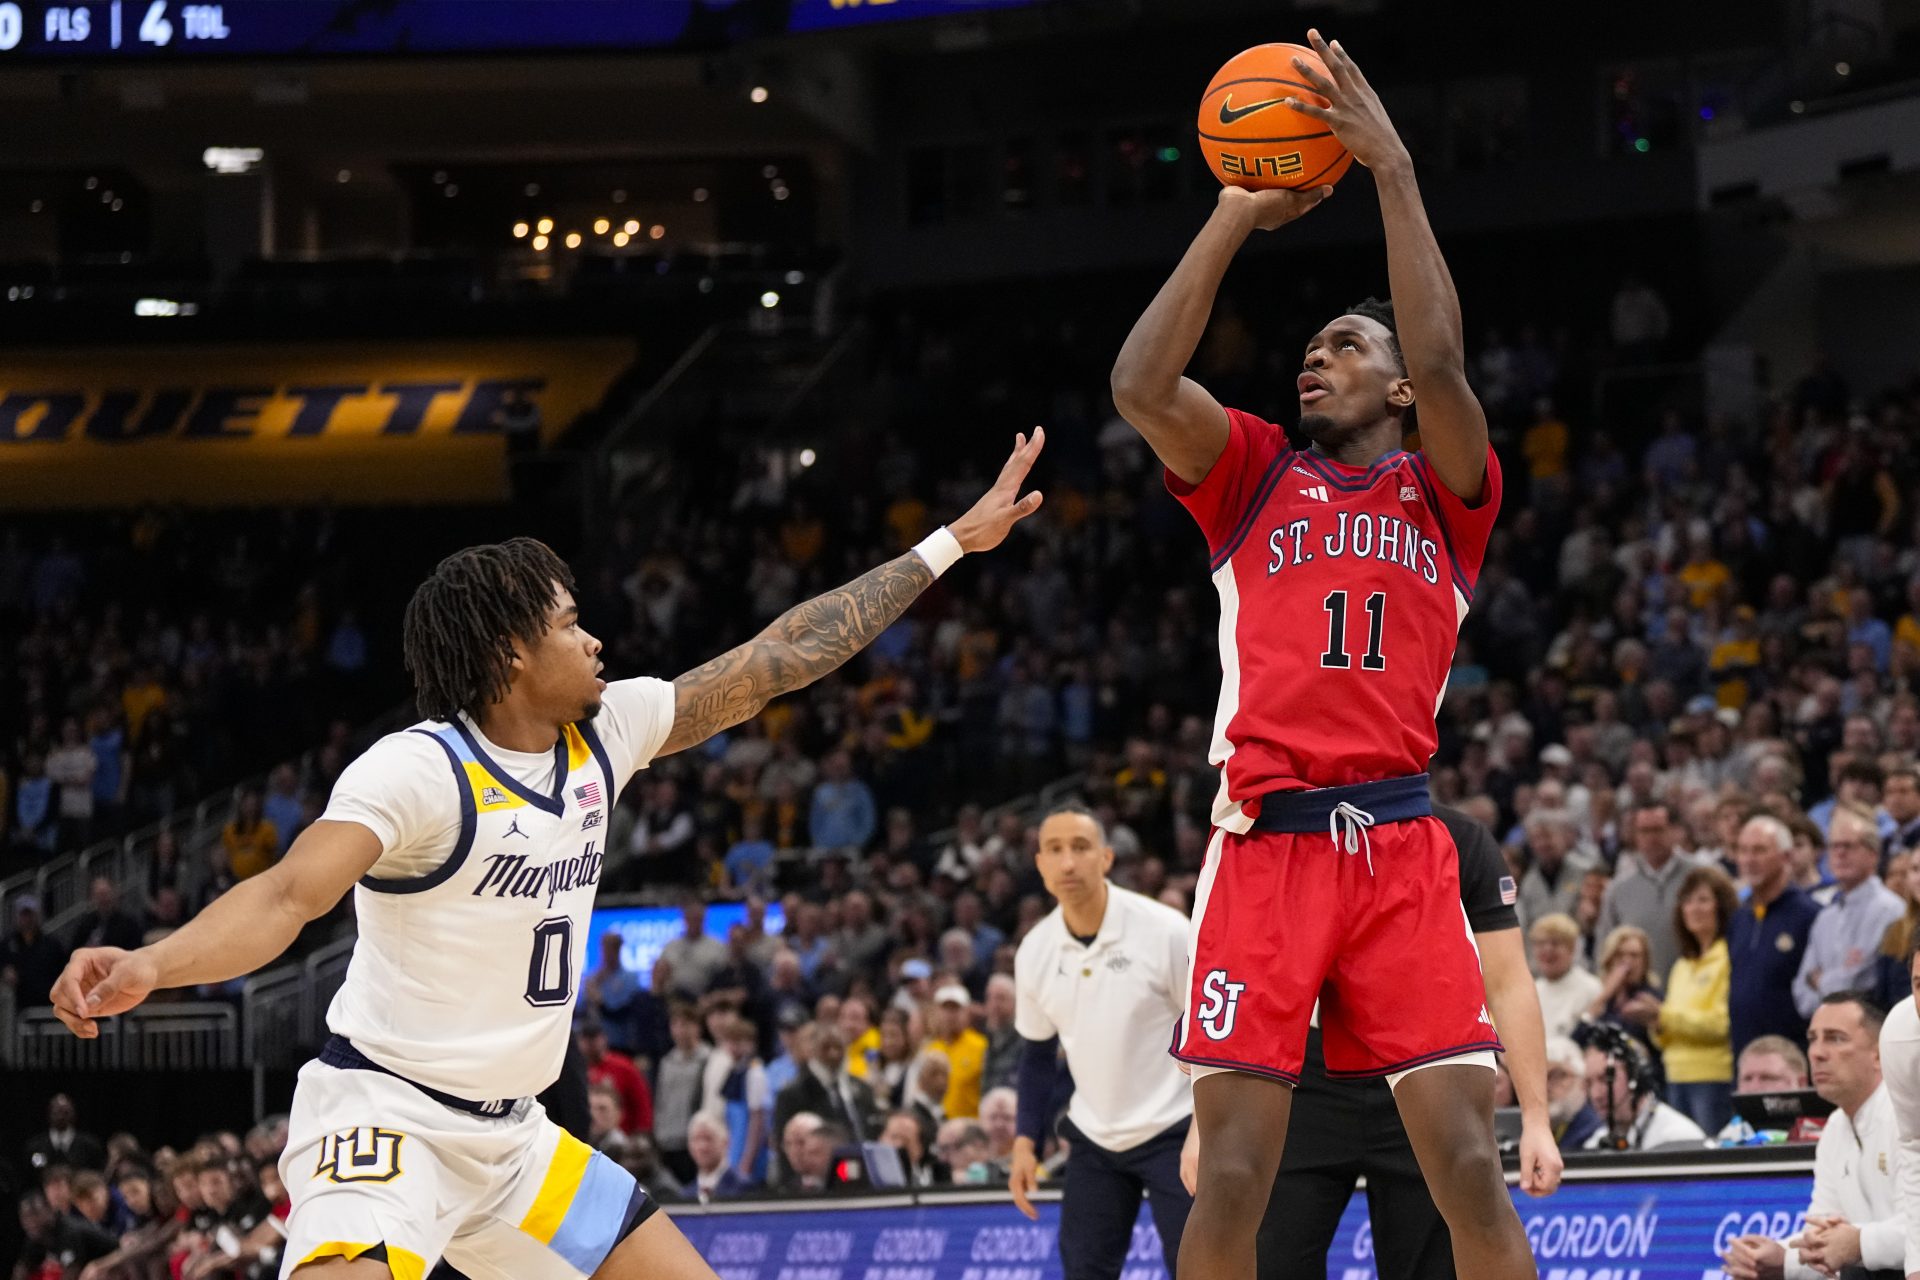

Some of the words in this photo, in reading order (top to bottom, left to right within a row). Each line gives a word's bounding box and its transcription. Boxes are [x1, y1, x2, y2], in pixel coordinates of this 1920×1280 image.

[45, 7, 91, 41] FLS
[139, 0, 173, 46] 4
[1268, 518, 1314, 577] ST.
[1324, 511, 1438, 585] JOHNS
[1320, 590, 1387, 672] 11
[582, 816, 603, 828] EAST
[585, 810, 601, 820] BIG
[471, 841, 605, 910] Marquette
[523, 914, 574, 1007] 0
[971, 1226, 1056, 1262] GORDON
[1525, 1214, 1658, 1258] GORDON
